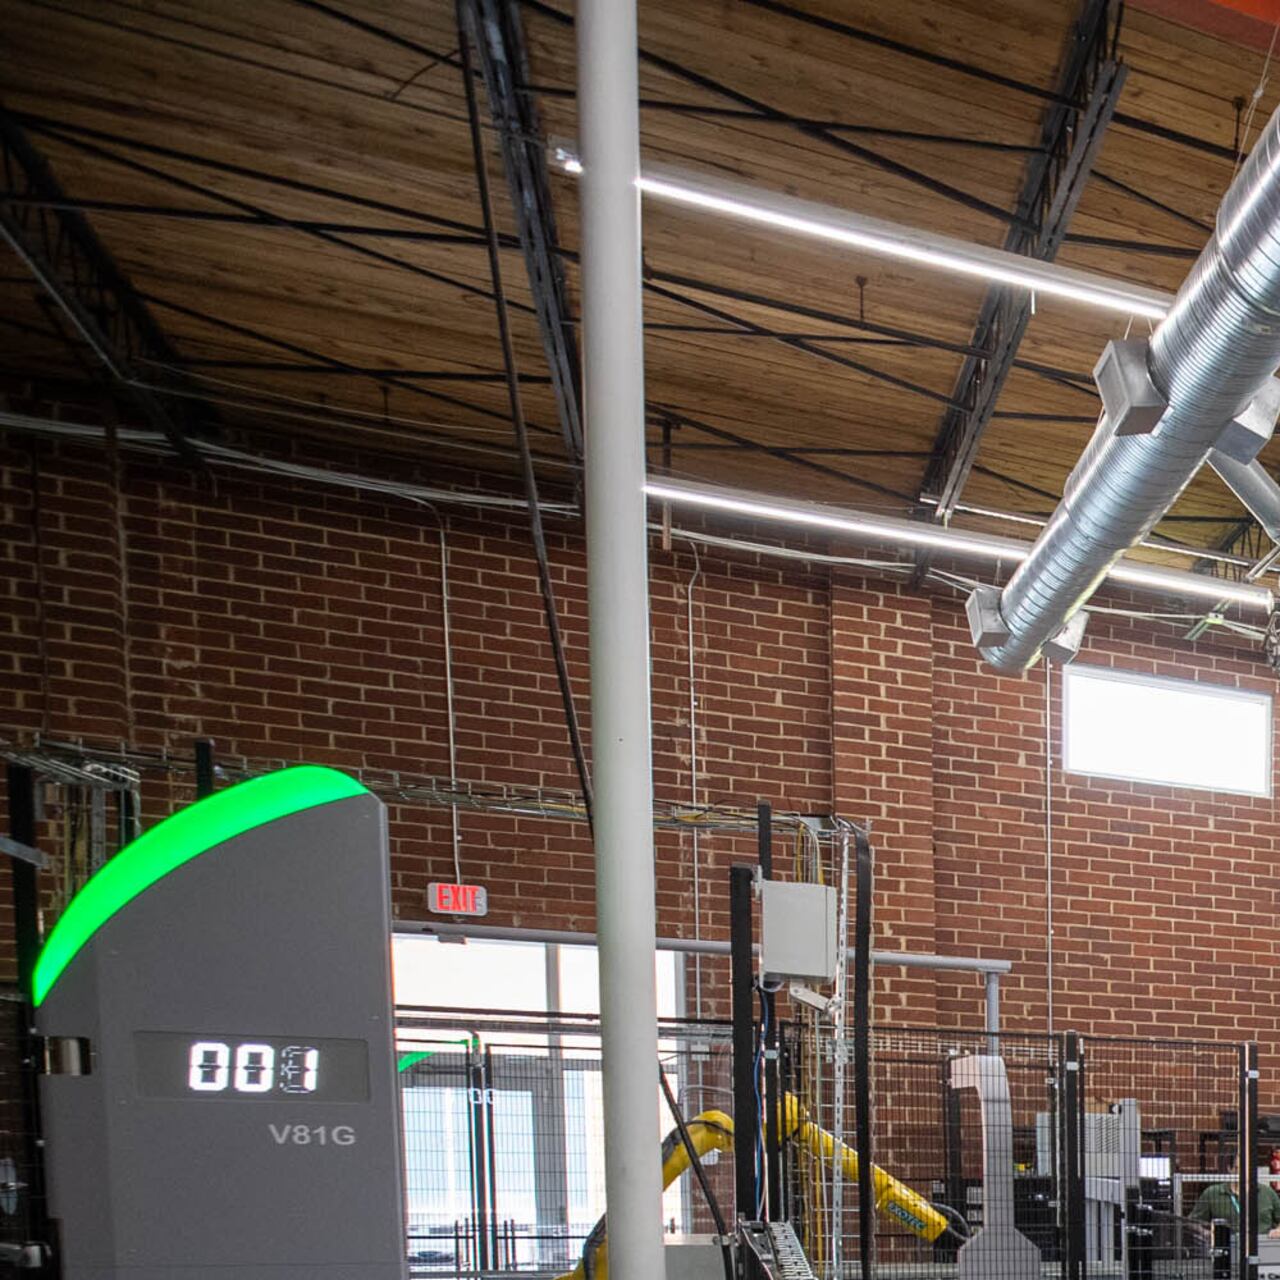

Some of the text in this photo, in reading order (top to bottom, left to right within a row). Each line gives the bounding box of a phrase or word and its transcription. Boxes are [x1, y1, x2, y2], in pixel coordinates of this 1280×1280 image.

[436, 884, 480, 913] EXIT
[188, 1042, 319, 1093] 001
[268, 1123, 356, 1146] V81G
